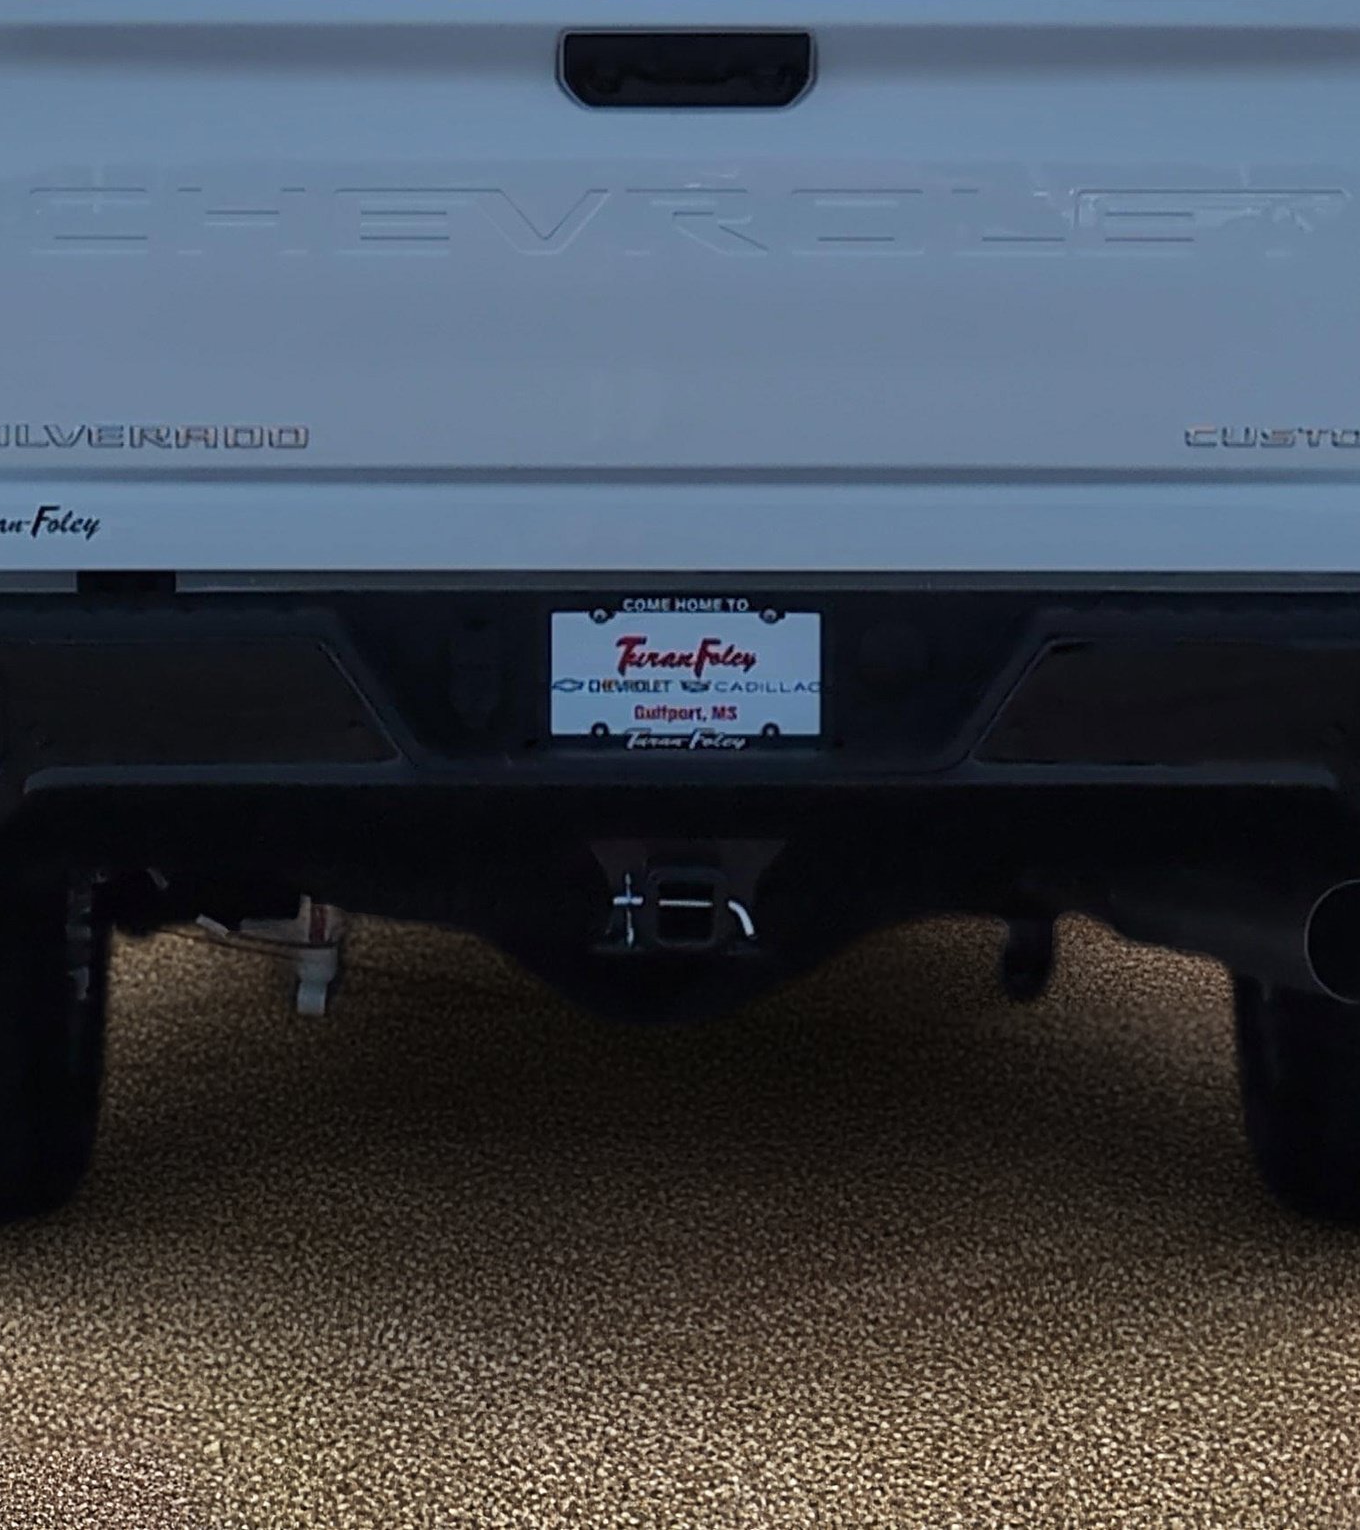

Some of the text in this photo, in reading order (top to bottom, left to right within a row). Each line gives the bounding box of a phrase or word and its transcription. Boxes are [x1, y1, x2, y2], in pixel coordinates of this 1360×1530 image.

[623, 598, 749, 612] COME HOME TO
[589, 679, 821, 693] CHEVROLET CADILLAC
[634, 705, 738, 722] Gulfport, MS
